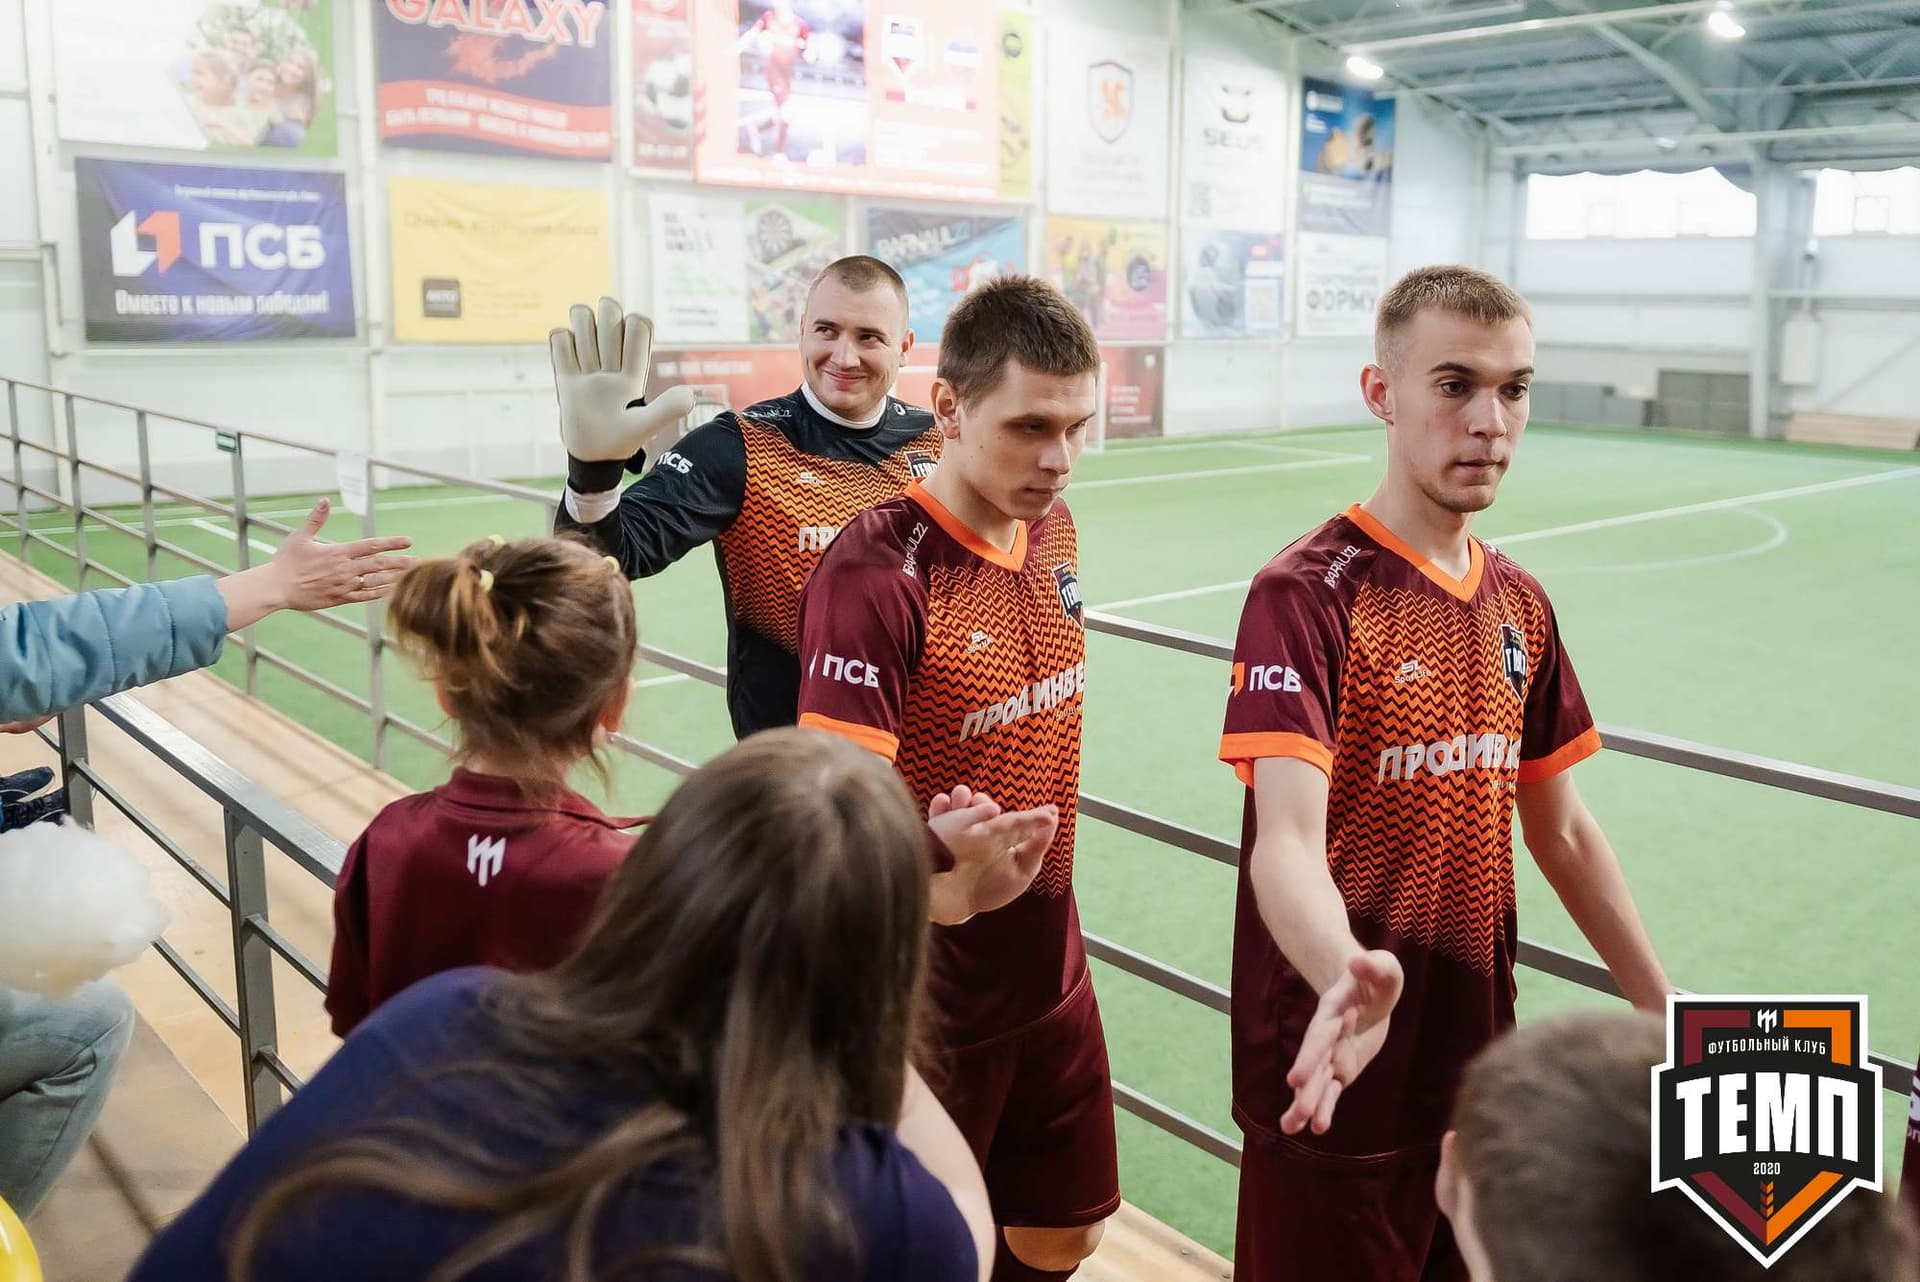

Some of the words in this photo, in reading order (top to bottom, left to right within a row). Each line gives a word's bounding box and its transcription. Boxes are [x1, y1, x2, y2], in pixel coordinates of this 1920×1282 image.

[384, 0, 604, 48] GALAXY
[199, 222, 326, 270] ПСБ
[657, 451, 693, 474] ПСБ
[799, 526, 842, 552] ПР
[823, 654, 880, 688] ПСБ
[1249, 665, 1302, 692] ПСБ
